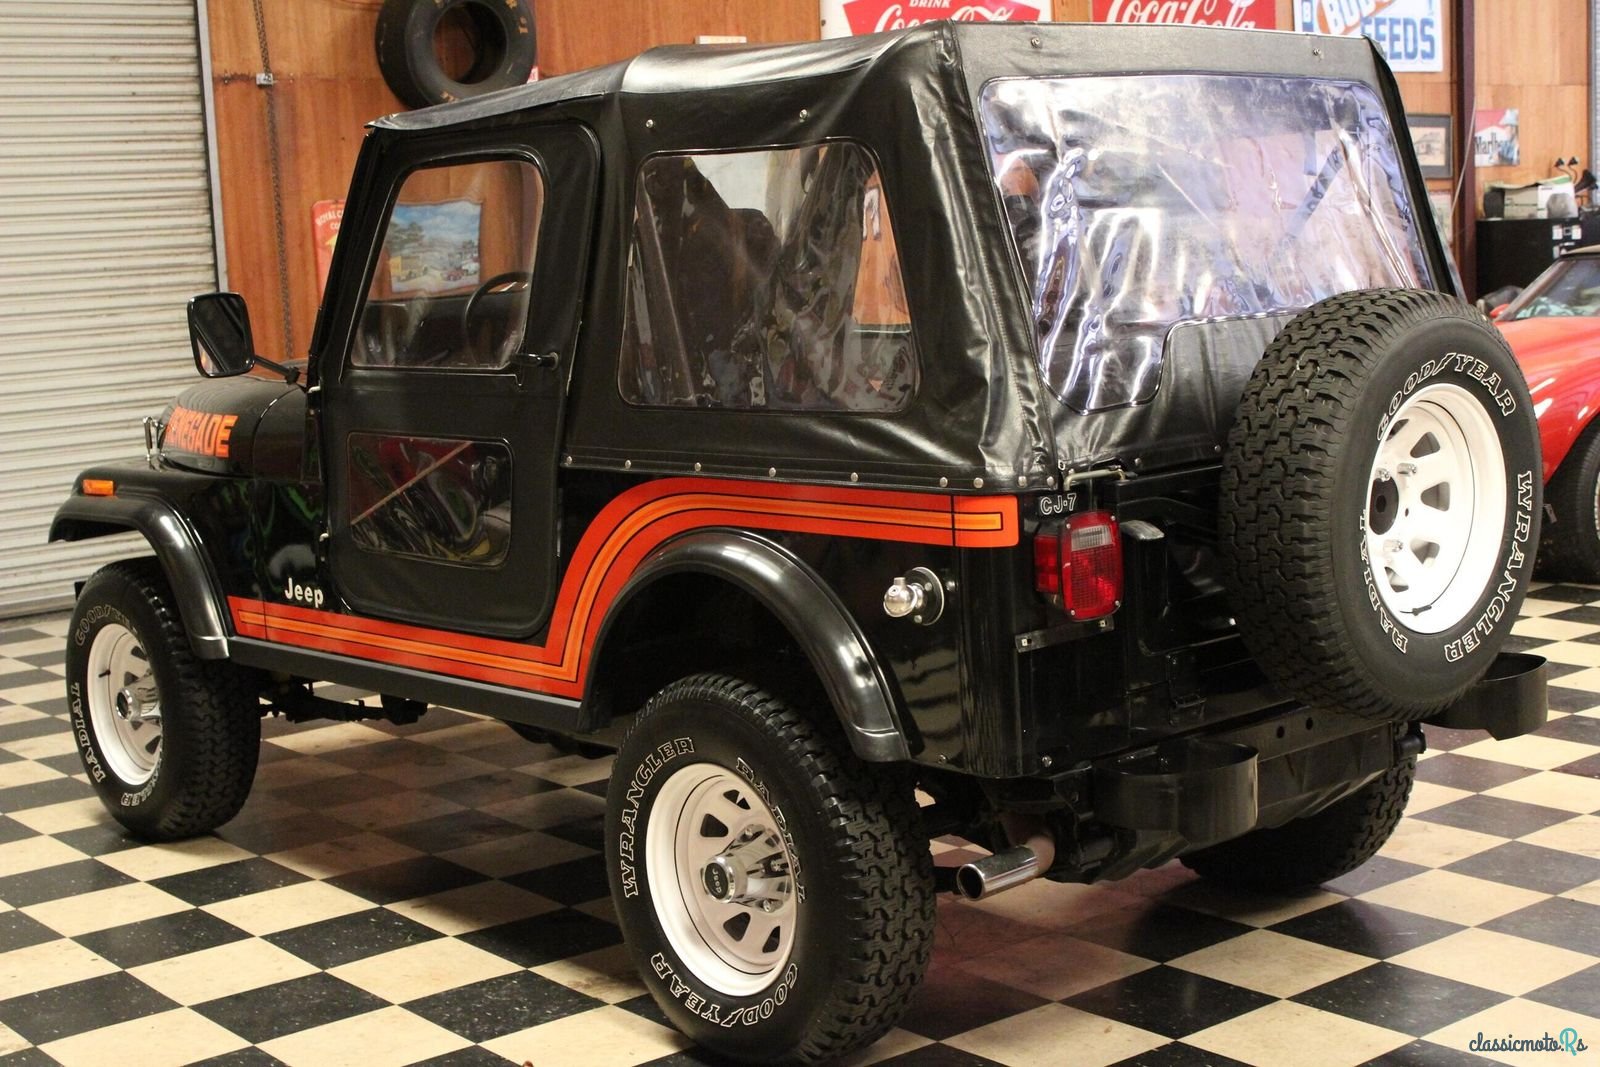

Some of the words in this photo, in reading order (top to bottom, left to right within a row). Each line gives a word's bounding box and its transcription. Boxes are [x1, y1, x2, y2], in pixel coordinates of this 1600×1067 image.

[1040, 493, 1077, 516] CJ-7
[284, 577, 325, 609] Jeep
[1358, 509, 1409, 655] RADIAL
[1444, 471, 1533, 664] WRANGLER
[70, 682, 107, 784] RADIAL
[620, 737, 695, 897] WRANGLER
[712, 867, 722, 894] Jeep
[650, 952, 799, 1028] GOODYEAR
